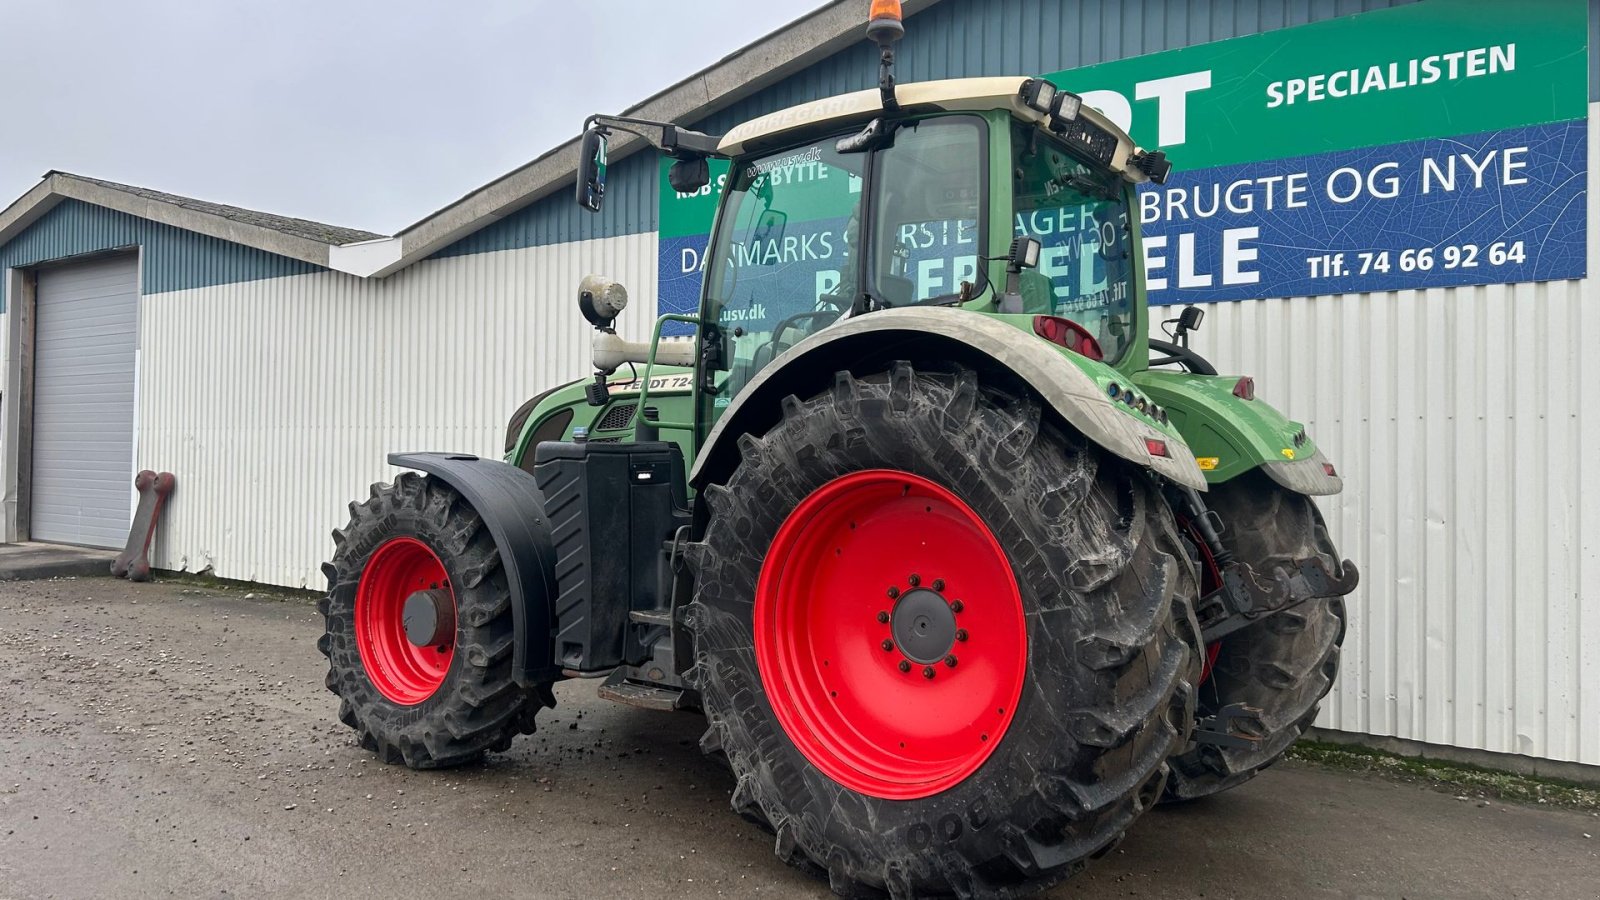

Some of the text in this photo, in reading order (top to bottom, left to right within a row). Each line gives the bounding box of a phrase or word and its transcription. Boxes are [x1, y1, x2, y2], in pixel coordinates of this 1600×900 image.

[1266, 43, 1516, 108] SPECIALISTEN
[747, 147, 822, 178] www.usv.dk
[1014, 202, 1100, 237] AGER
[1140, 172, 1308, 224] BRUGTE
[1326, 161, 1400, 203] OG
[1423, 146, 1529, 195] NYE
[1307, 241, 1526, 279] Tlf. 74 66 92 64
[623, 378, 669, 390] FEDT
